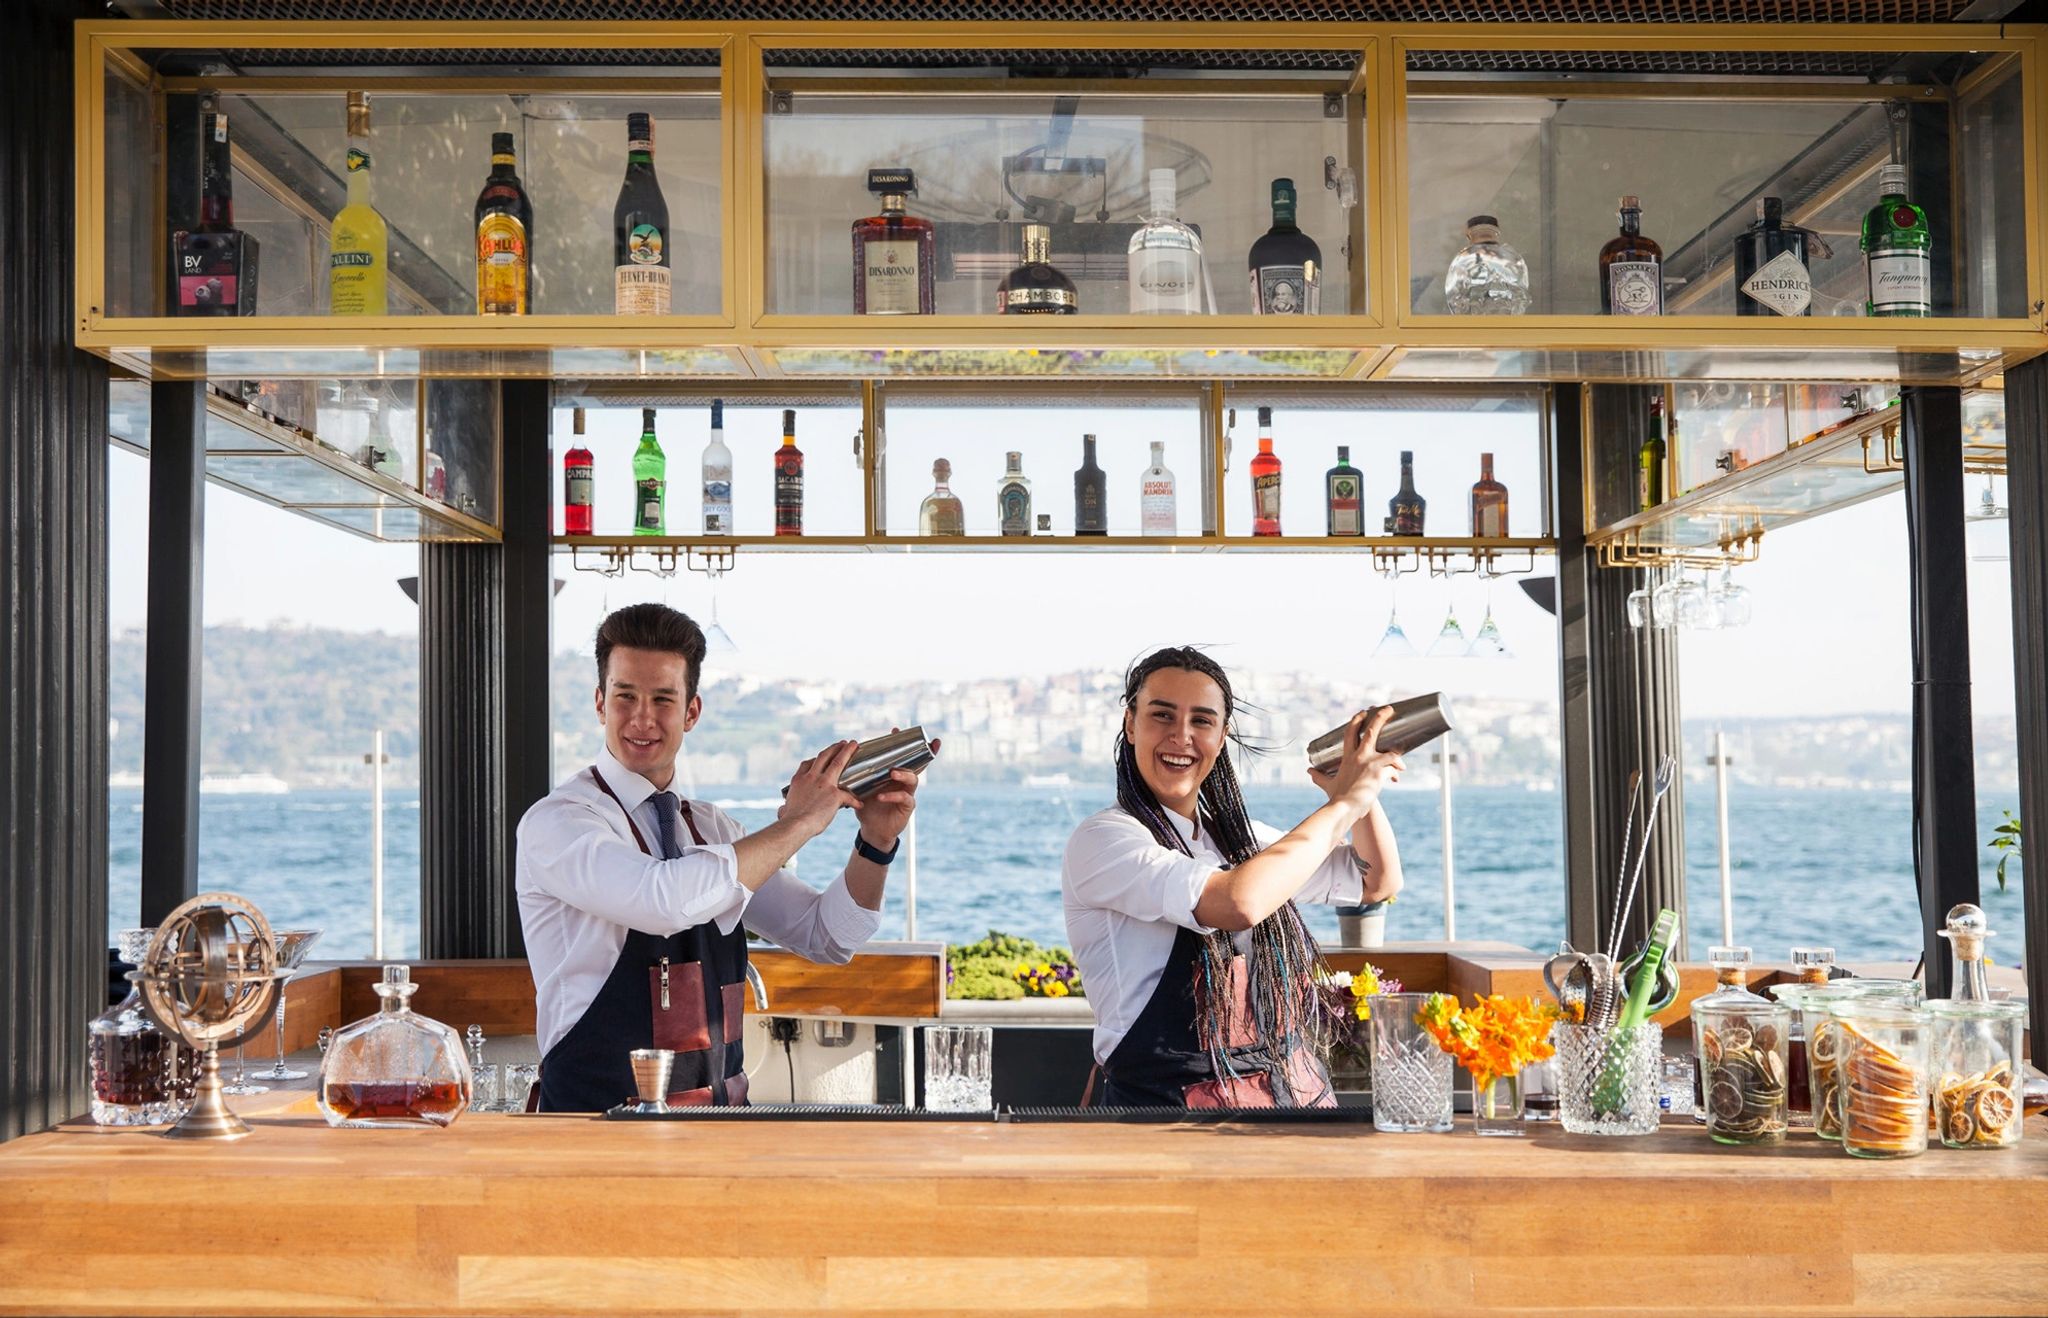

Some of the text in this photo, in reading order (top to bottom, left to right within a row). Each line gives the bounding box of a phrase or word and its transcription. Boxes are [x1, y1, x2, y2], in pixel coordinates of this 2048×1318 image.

[872, 174, 909, 184] DISARONNO
[184, 255, 203, 268] BV
[332, 253, 370, 266] ALLINI
[868, 265, 915, 277] DISARONNO
[620, 270, 670, 286] FERNET-BRANC
[1007, 290, 1076, 304] CHAMBORD
[1144, 481, 1172, 489] ABSOLUT
